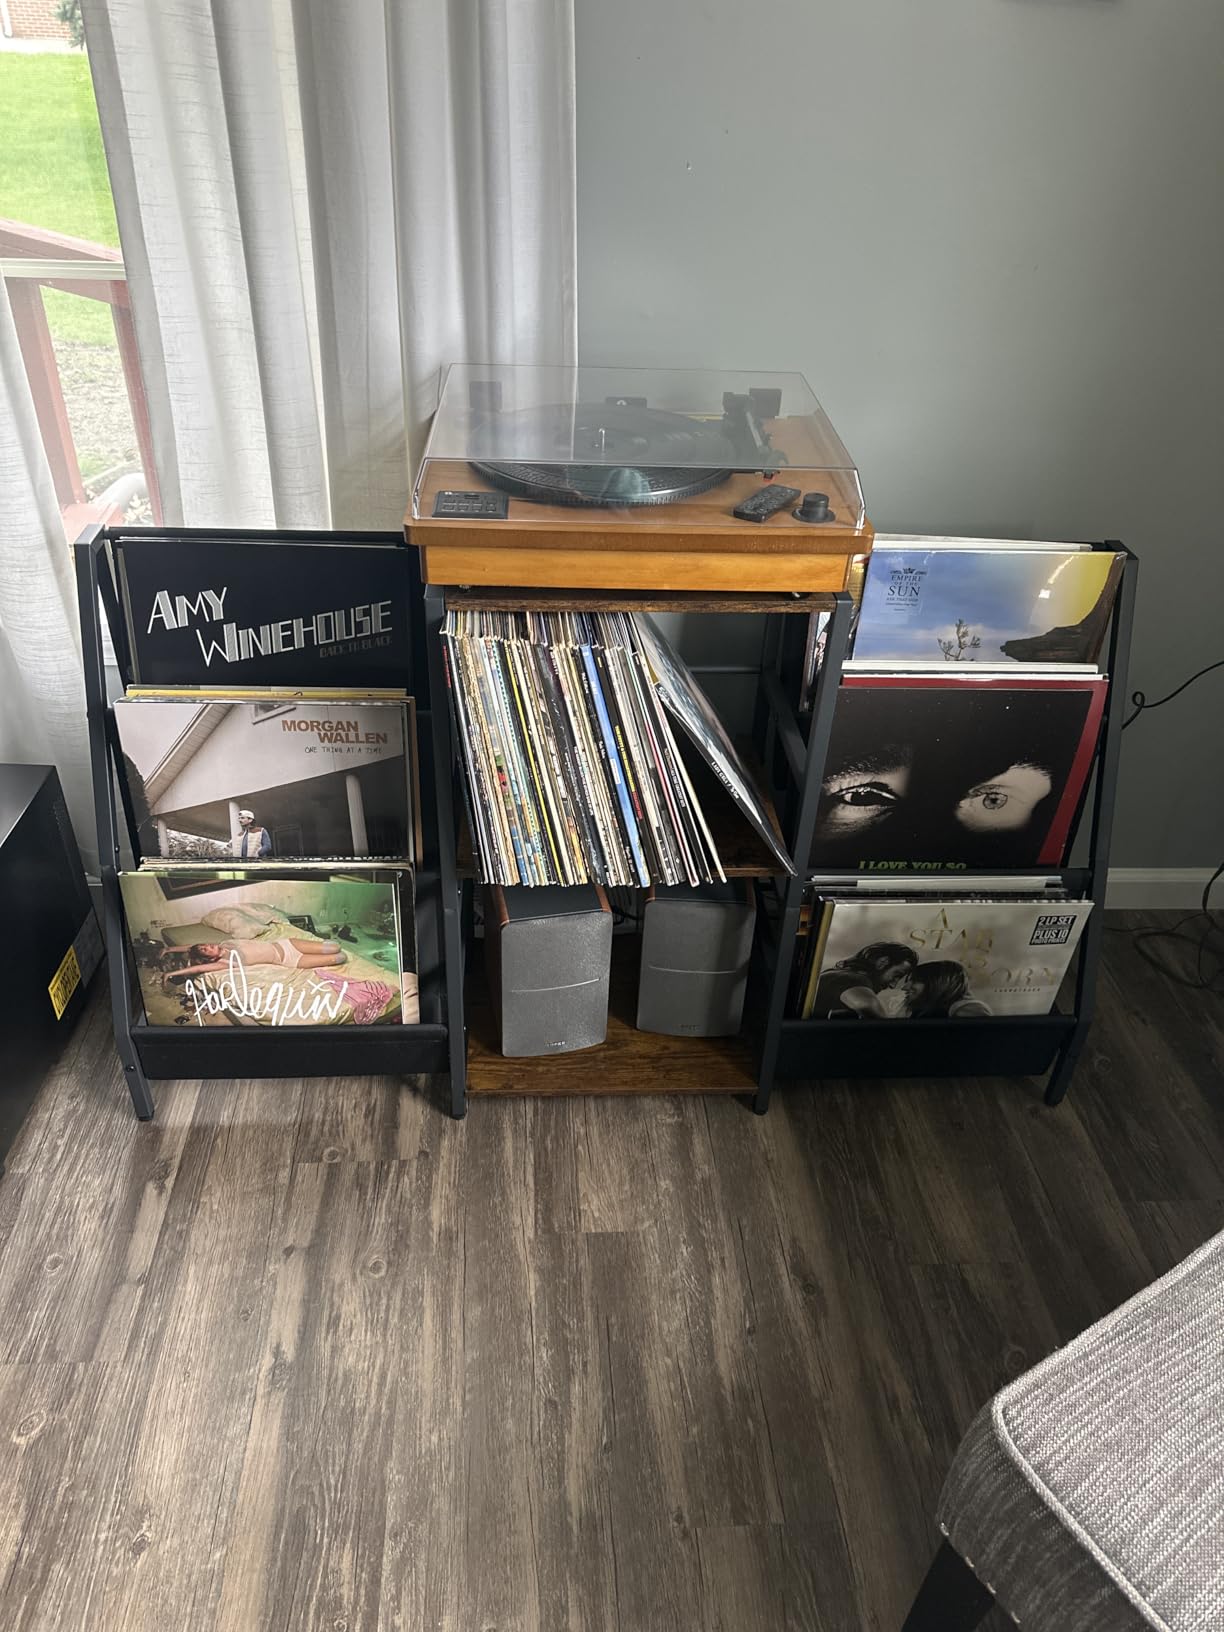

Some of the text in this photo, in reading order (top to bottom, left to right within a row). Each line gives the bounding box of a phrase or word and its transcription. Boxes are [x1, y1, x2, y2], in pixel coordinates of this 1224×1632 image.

[888, 586, 920, 596] SUN
[148, 587, 227, 634] AMY
[196, 600, 392, 667] WINEHOUSE
[282, 720, 358, 732] MORGAN
[318, 733, 388, 744] WALLEN
[859, 861, 967, 870] I LOVE YOU SO
[935, 908, 949, 928] A
[1039, 916, 1074, 925] 2 LP SET
[1034, 930, 1068, 938] PLUS 10
[910, 928, 993, 952] STAR
